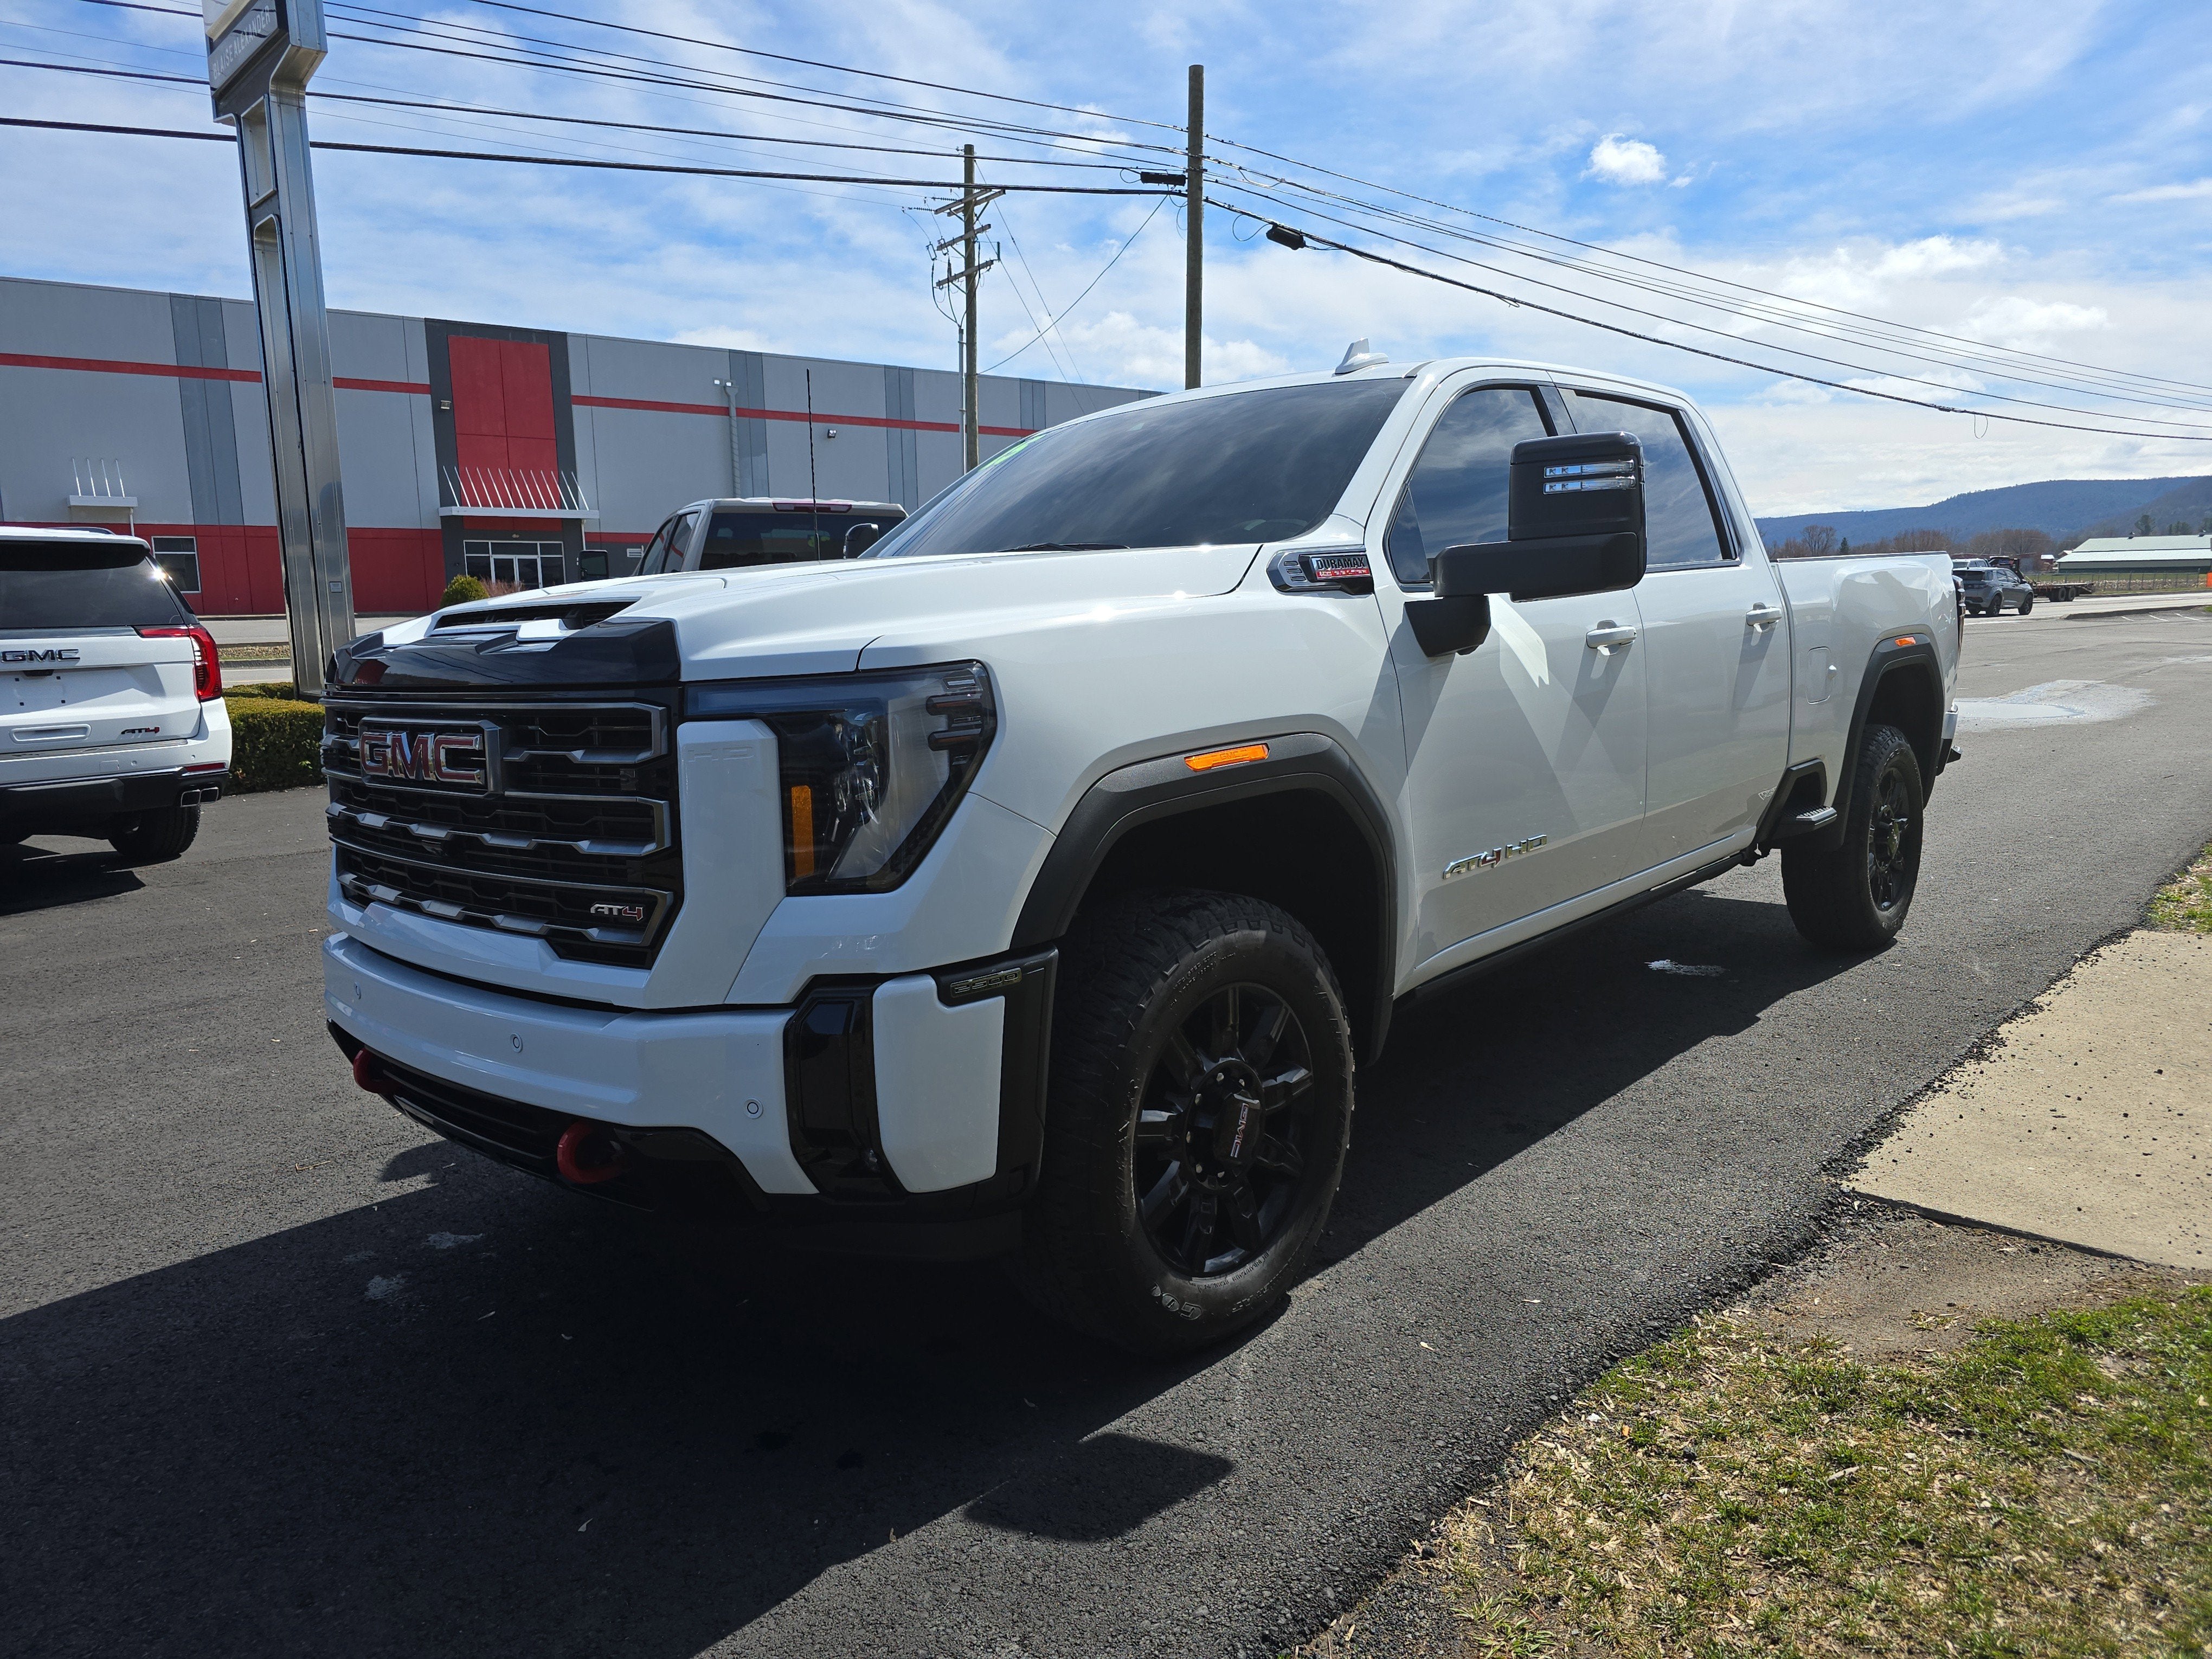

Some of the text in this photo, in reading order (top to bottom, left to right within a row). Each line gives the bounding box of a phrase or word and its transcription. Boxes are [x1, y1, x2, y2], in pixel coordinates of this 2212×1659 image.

[213, 5, 271, 79] BLAISE ALEXANDER
[1316, 556, 1365, 570] DURAMAX
[1, 648, 80, 663] GMC
[120, 726, 160, 735] AT4
[360, 731, 486, 785] GMC
[1442, 833, 1547, 879] AT4 HD
[589, 903, 644, 922] AT4
[1230, 1102, 1250, 1158] GMC
